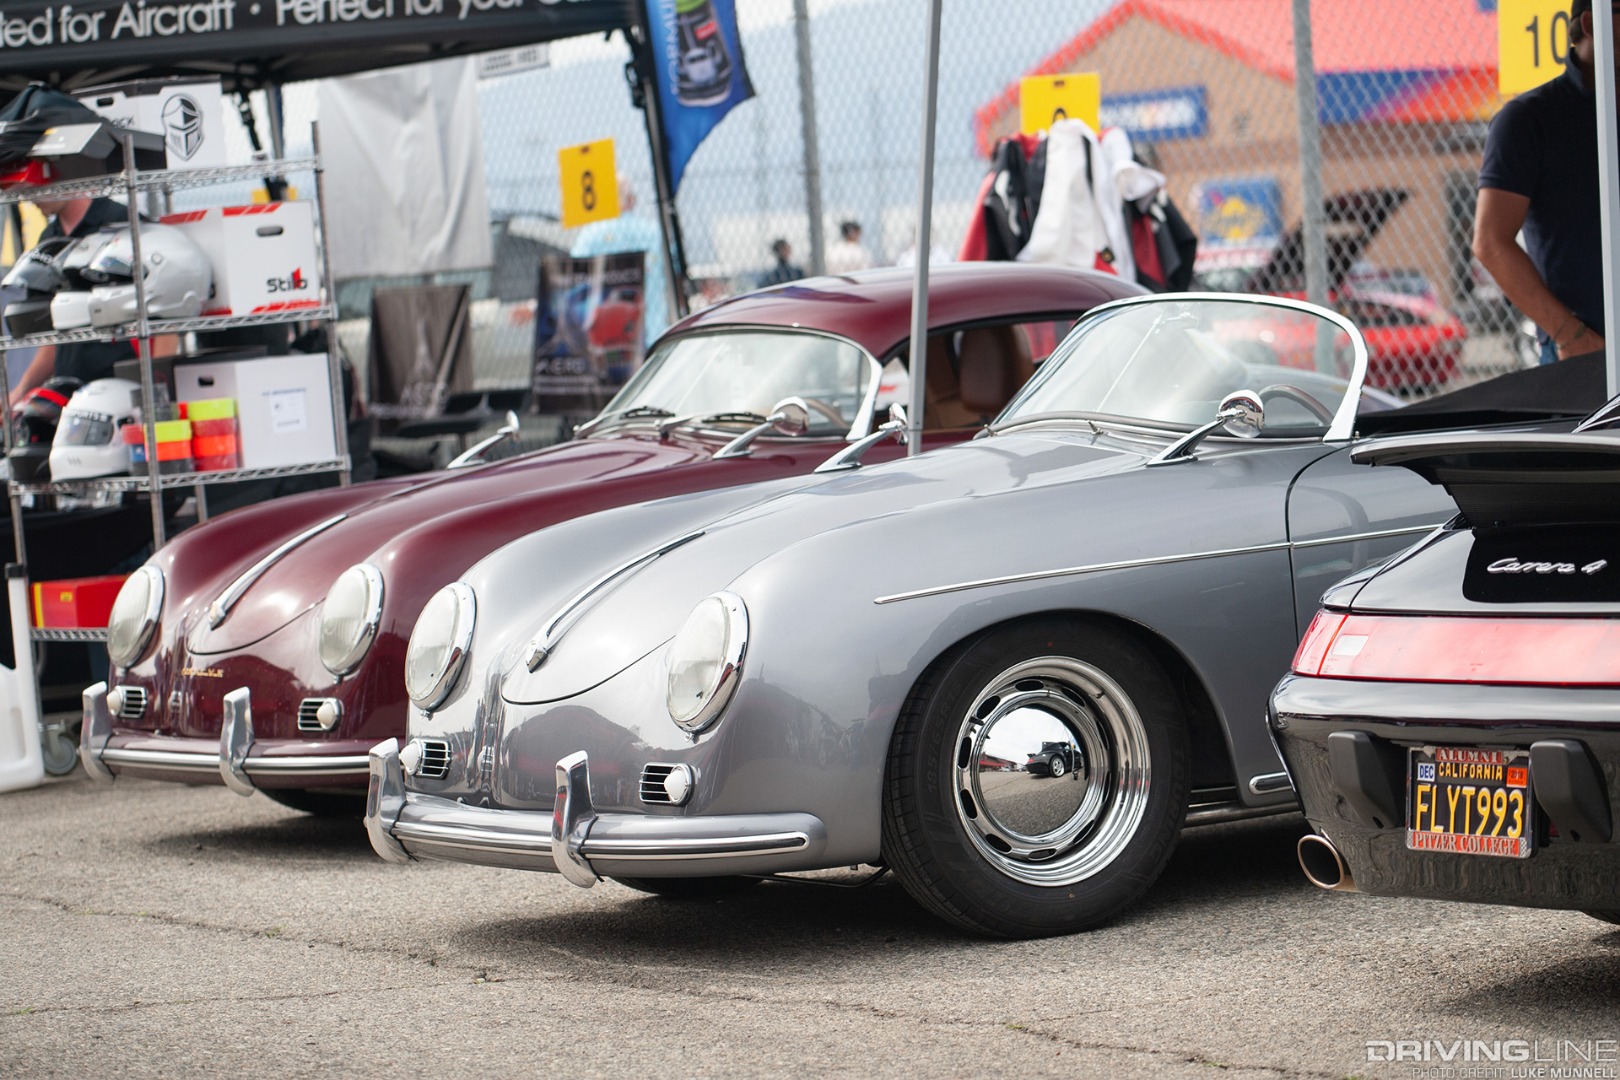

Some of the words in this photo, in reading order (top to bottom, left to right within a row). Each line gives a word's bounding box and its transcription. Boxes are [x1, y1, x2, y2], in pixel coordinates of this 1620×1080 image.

[58, 5, 106, 43] for
[110, 0, 237, 39] Aircraft
[275, 0, 394, 26] Perfect
[1525, 10, 1570, 68] 10
[580, 170, 597, 212] 8
[1487, 557, 1576, 574] Carrera
[1581, 559, 1608, 575] 4
[1439, 749, 1498, 763] ALUMNI
[1419, 765, 1434, 779] DEC
[1438, 762, 1503, 781] CALIFORNIA
[1416, 783, 1524, 838] FLYT993
[1415, 833, 1457, 851] PITZER
[1459, 836, 1517, 856] COLLEGE
